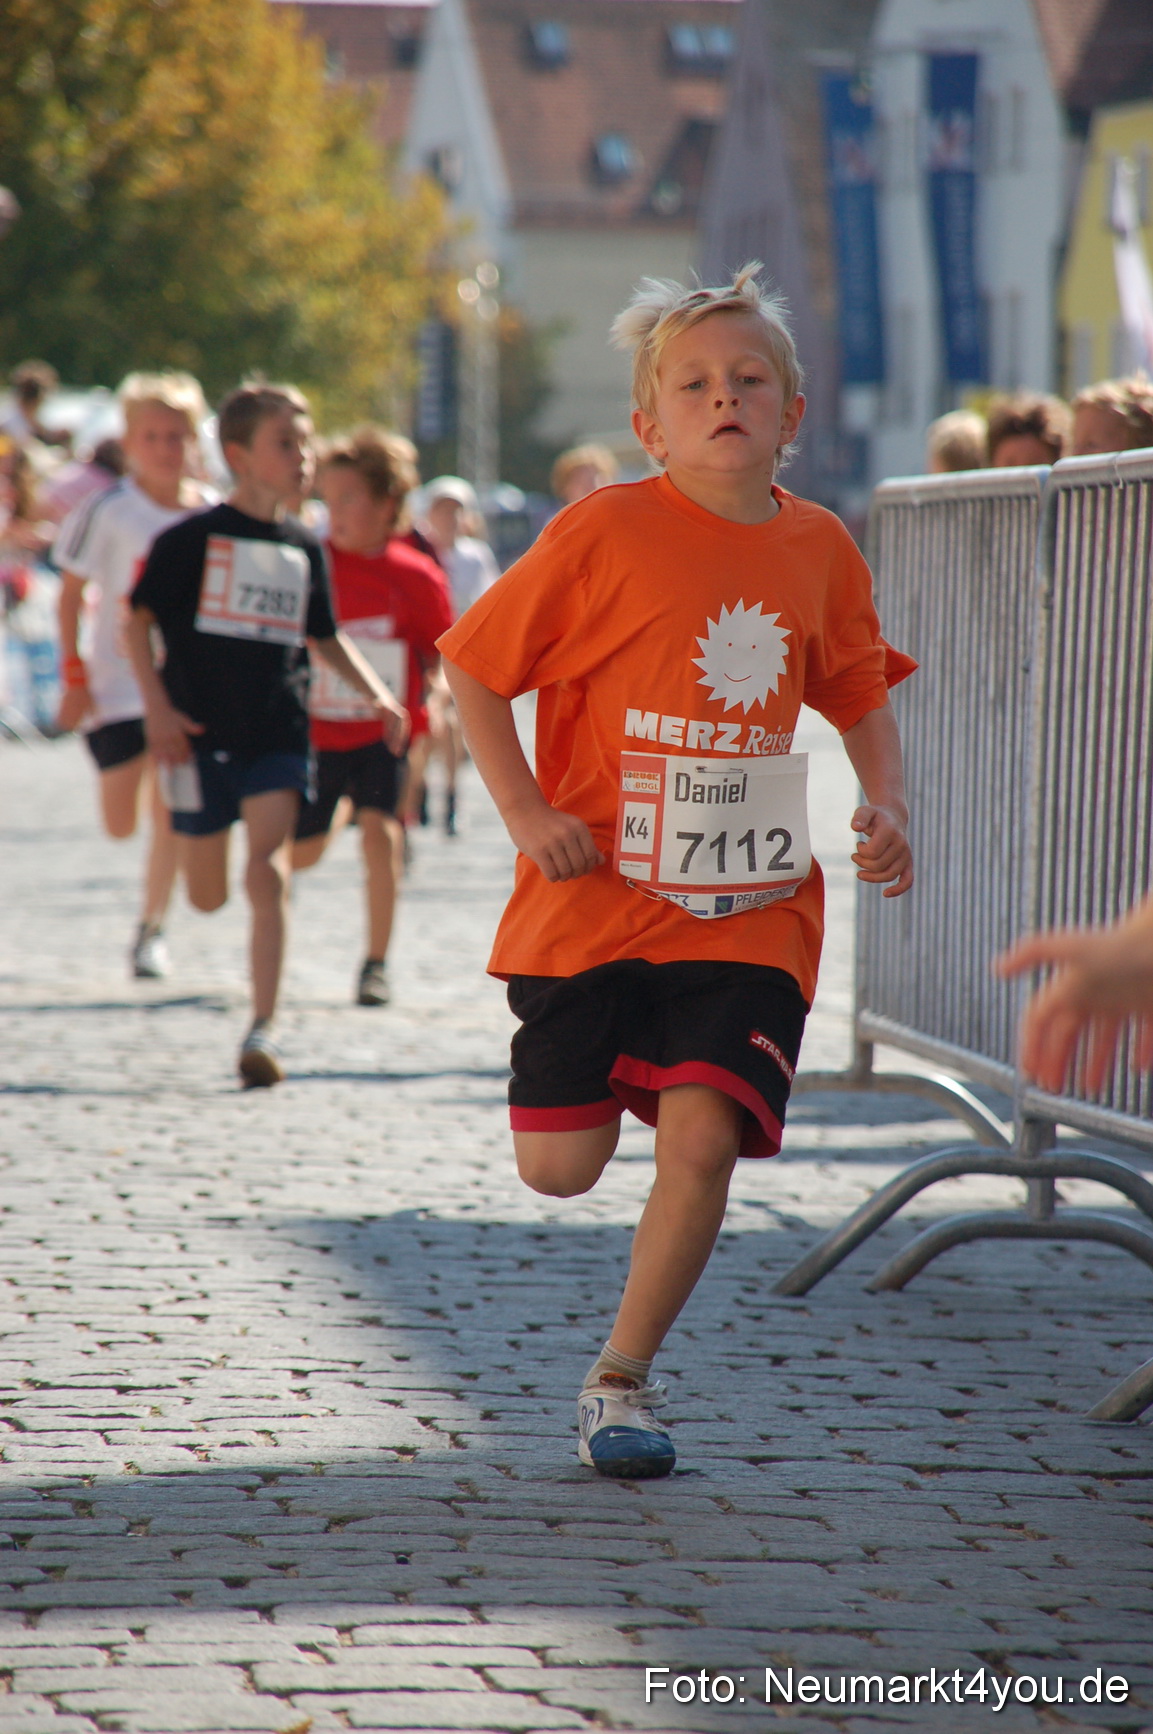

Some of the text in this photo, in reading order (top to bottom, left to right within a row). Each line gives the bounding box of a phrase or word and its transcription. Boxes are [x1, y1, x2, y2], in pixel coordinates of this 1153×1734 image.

[625, 708, 742, 753] MERZ
[674, 772, 748, 804] Daniel
[625, 816, 649, 839] K4
[676, 828, 795, 874] 7112
[751, 1035, 781, 1062] STAR
